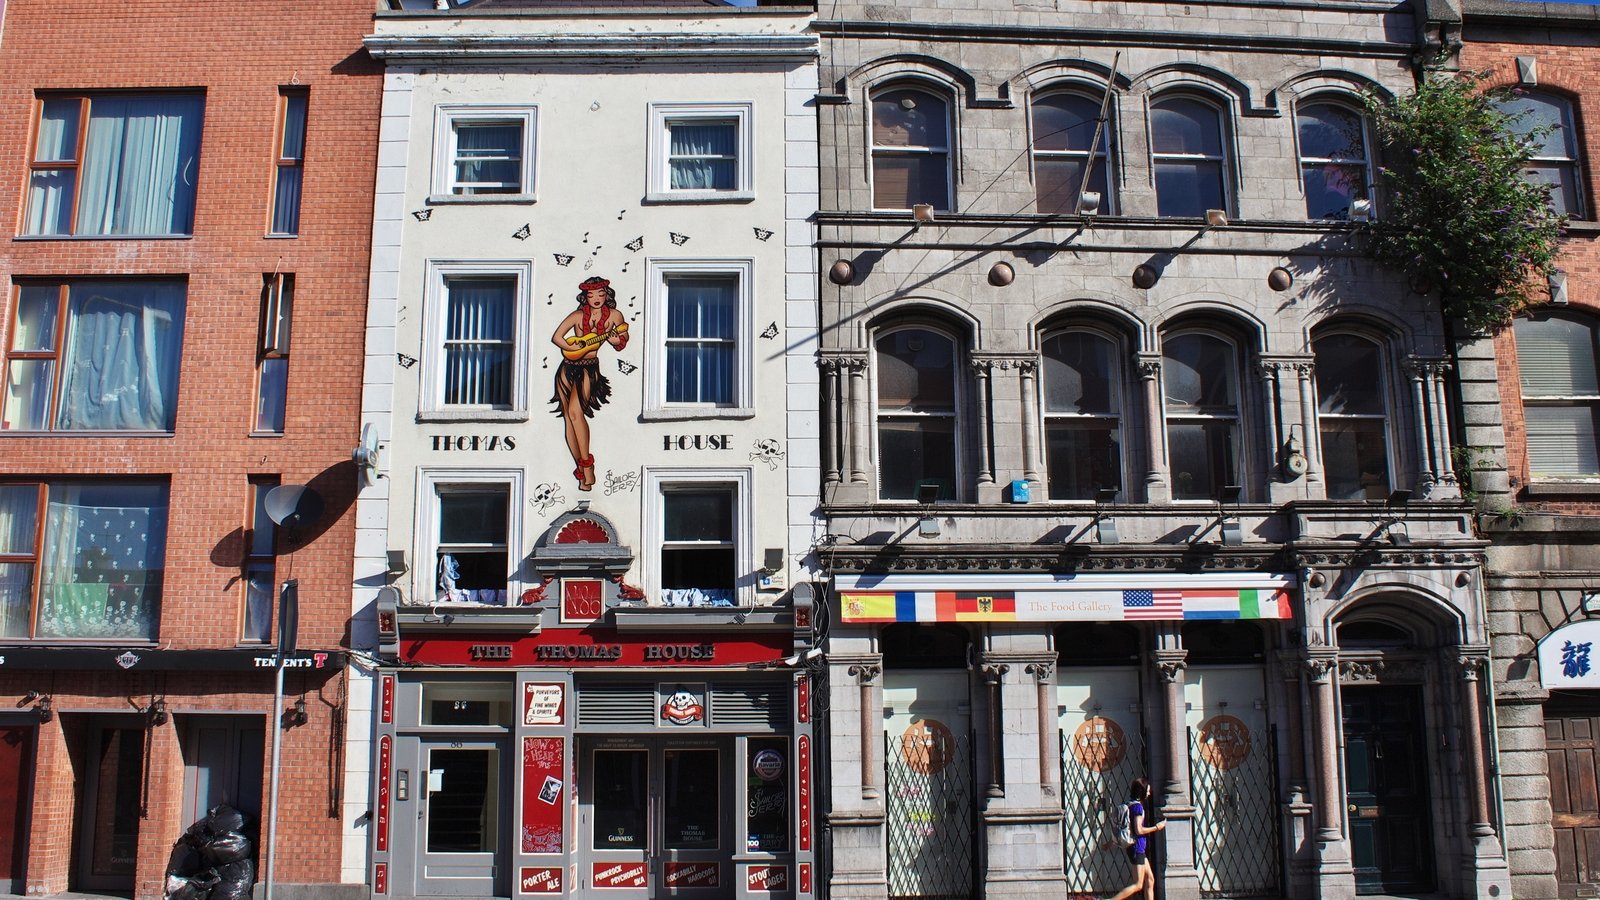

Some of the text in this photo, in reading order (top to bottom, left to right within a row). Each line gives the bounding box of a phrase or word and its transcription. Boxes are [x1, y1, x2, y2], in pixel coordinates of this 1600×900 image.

[429, 435, 733, 451] THOMAS HOUSE
[604, 479, 641, 496] JERRY
[1028, 601, 1112, 613] The Food Gallery
[470, 645, 715, 660] THE THOMAS HOUSE
[254, 654, 312, 667] TENENT'S
[524, 738, 550, 751] NOW
[531, 749, 554, 761] HEAR
[523, 870, 551, 889] PORTER
[611, 866, 643, 886] PSYCHOBILLY
[634, 876, 645, 886] SKA
[749, 868, 770, 884] STOUT
[763, 873, 785, 889] LAGER
[547, 878, 560, 891] ALE
